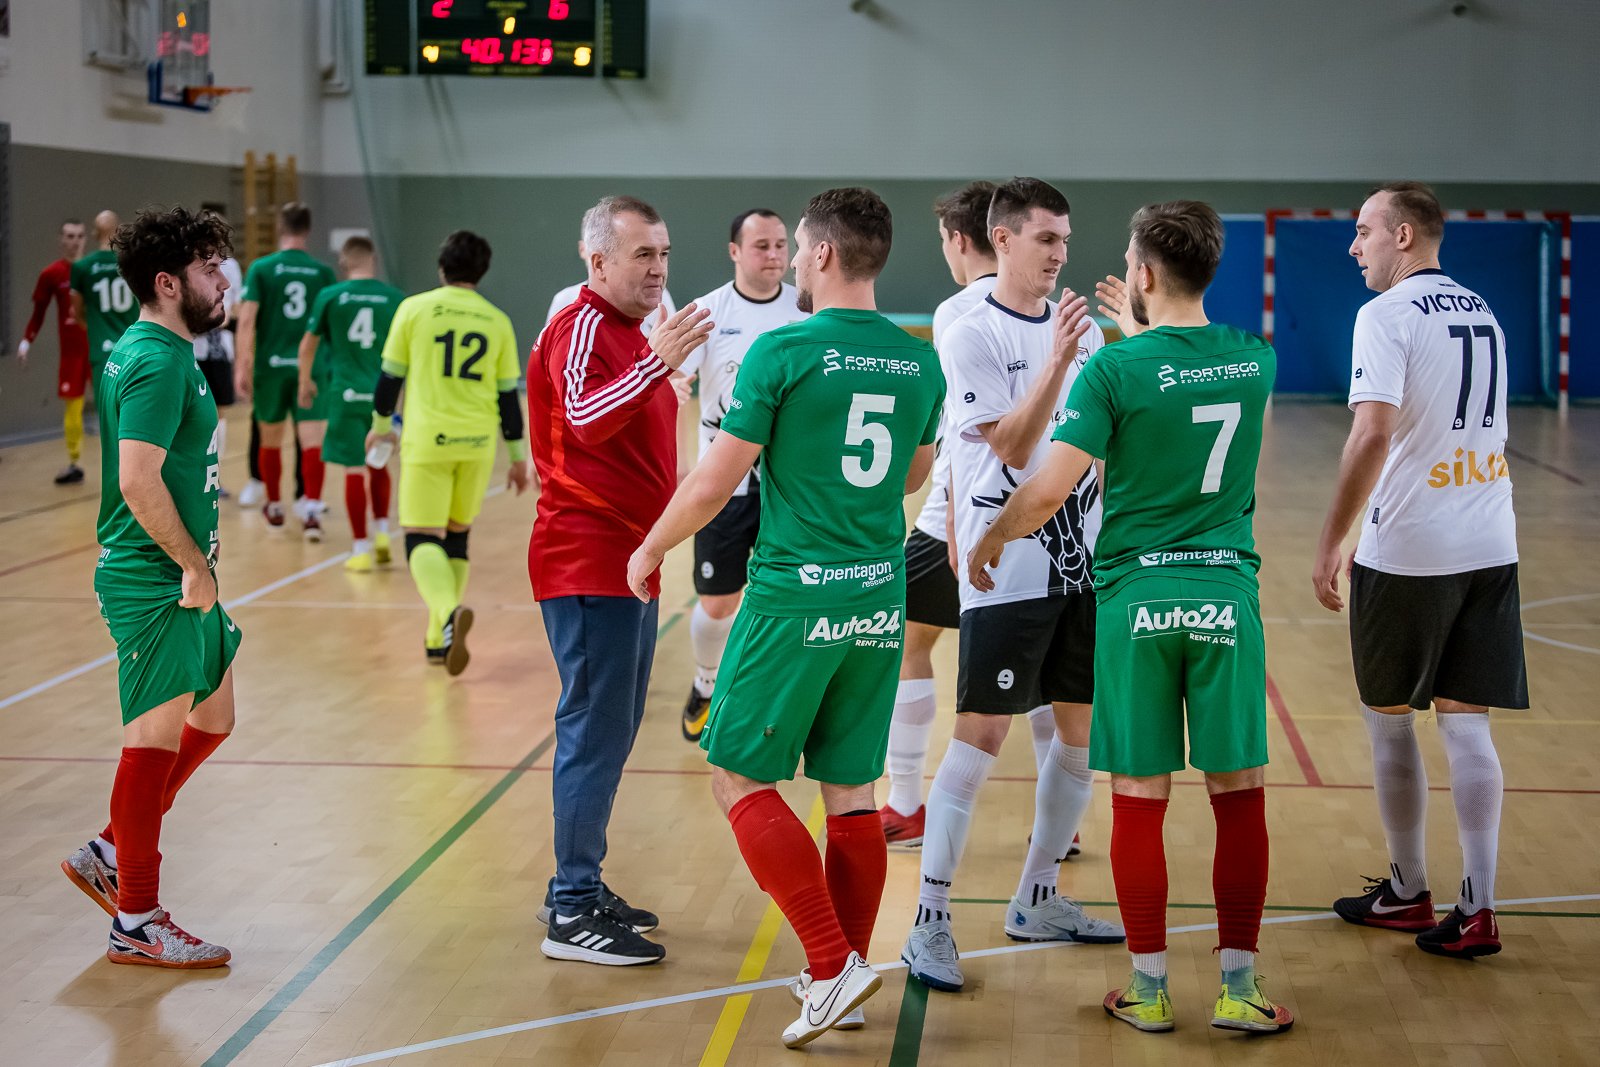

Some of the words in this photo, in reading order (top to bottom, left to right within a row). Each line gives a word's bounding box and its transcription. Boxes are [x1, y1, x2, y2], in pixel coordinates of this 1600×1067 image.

[92, 276, 133, 313] 10
[283, 281, 307, 320] 3
[347, 307, 376, 349] 4
[434, 329, 489, 382] 12
[845, 356, 920, 372] FORTISGO
[1179, 361, 1260, 379] FORTISGO
[1448, 325, 1498, 430] 77
[841, 393, 896, 488] 5
[1191, 402, 1241, 494] 7
[822, 561, 892, 585] pentagon
[862, 573, 895, 588] research
[807, 610, 901, 641] Auto24
[1133, 604, 1236, 633] Auto24
[877, 641, 884, 649] A
[885, 640, 900, 649] CAR
[1189, 633, 1211, 643] RENT
[1212, 637, 1219, 645] A
[1219, 636, 1236, 647] CAR
